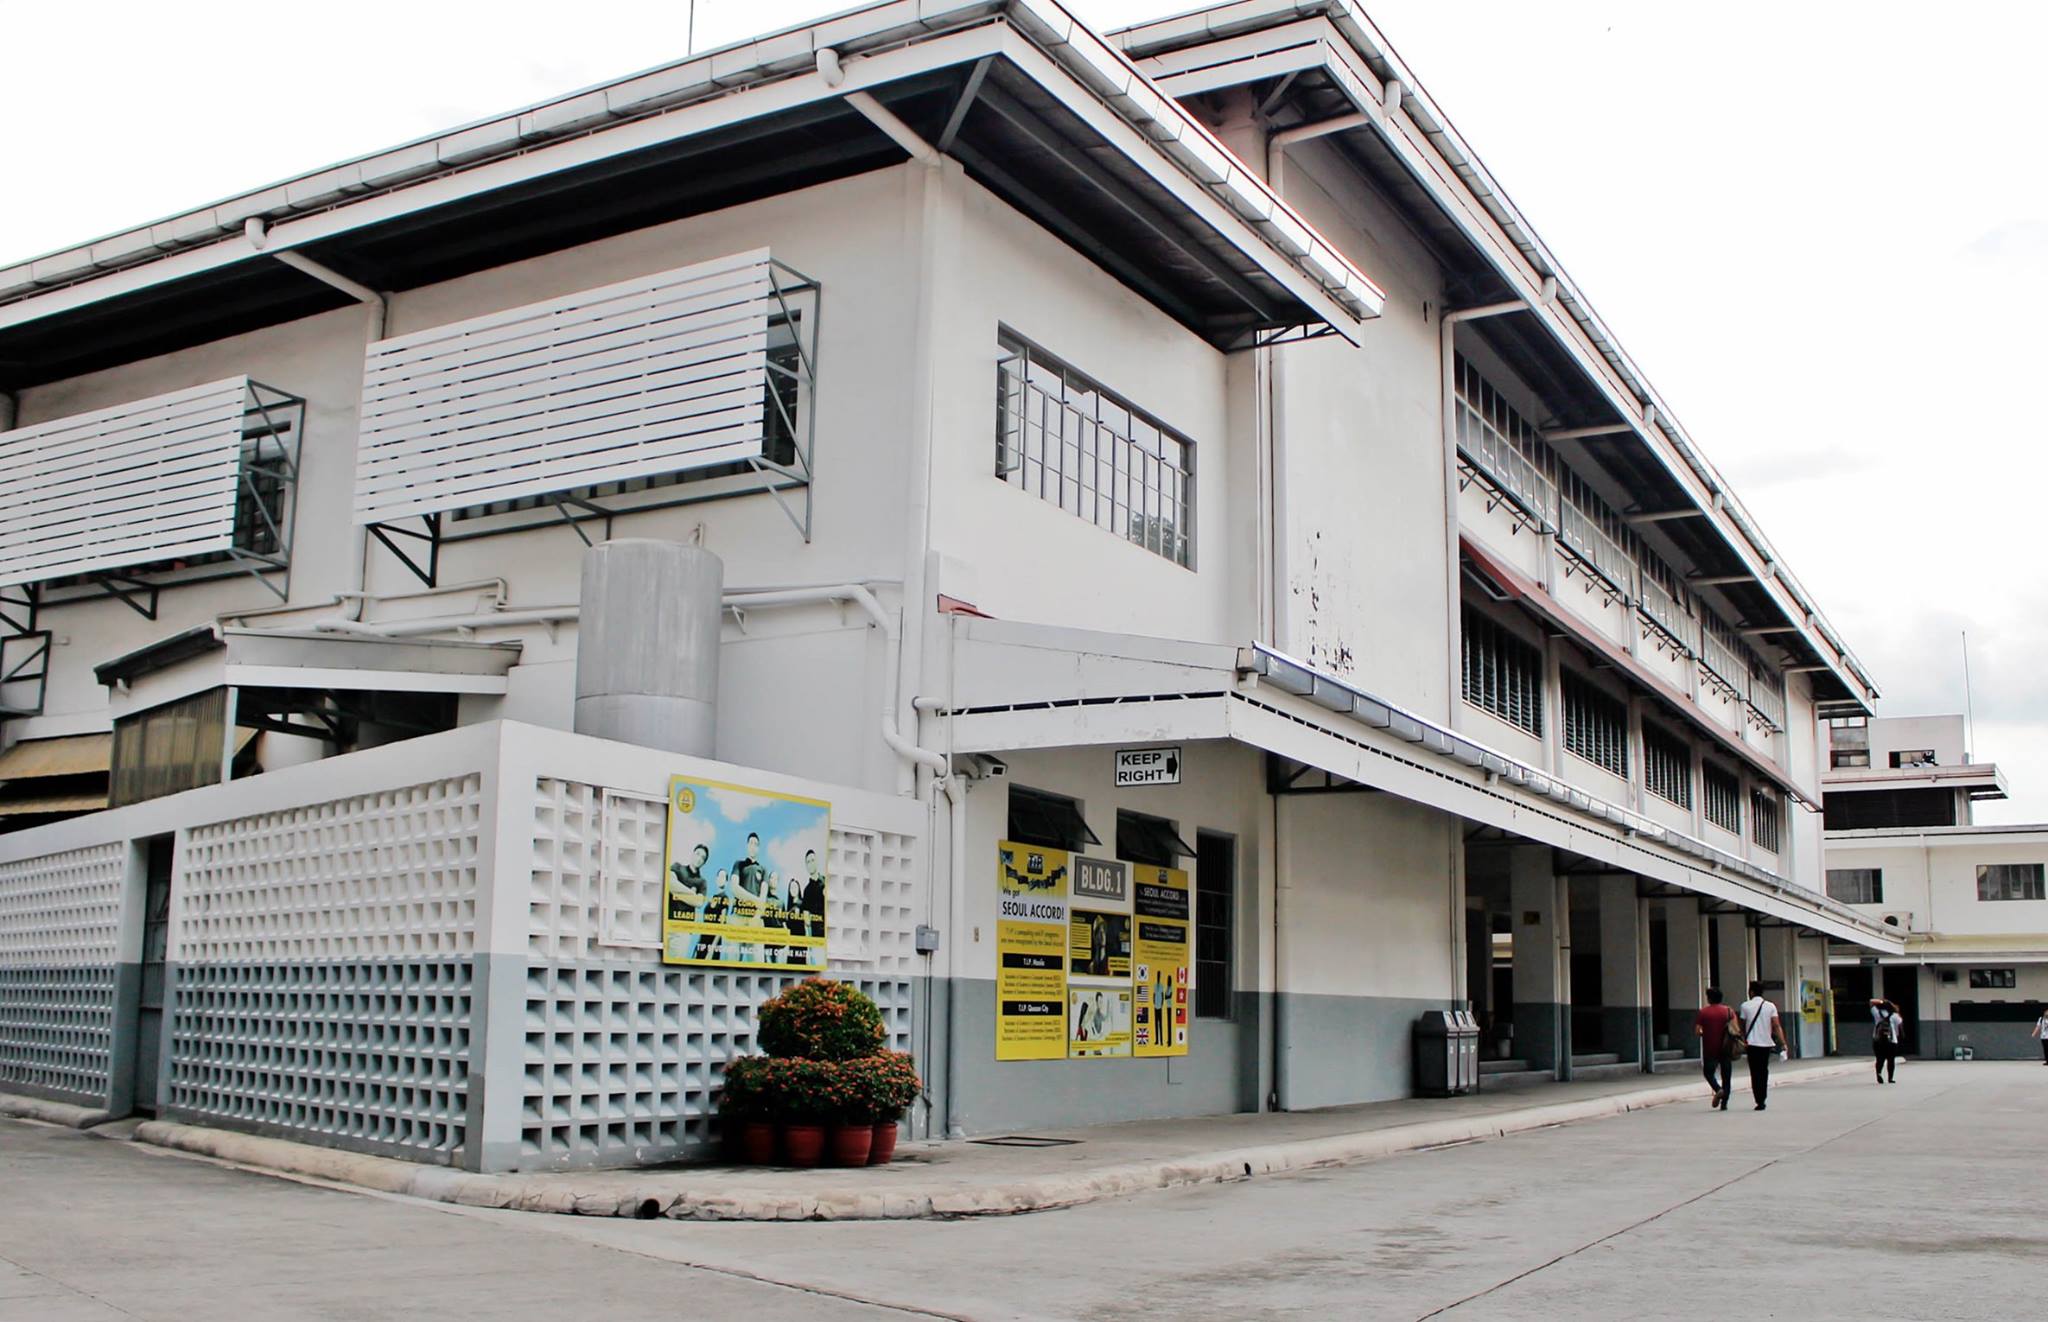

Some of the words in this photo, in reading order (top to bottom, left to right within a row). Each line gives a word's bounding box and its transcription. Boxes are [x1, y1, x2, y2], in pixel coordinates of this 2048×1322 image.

[1121, 753, 1161, 766] KEEP
[1118, 769, 1165, 783] RIGHT
[1081, 864, 1114, 892] BLDG.
[1116, 871, 1122, 894] 1
[1002, 901, 1028, 917] SEOUL
[1030, 904, 1064, 920] ACCORD!
